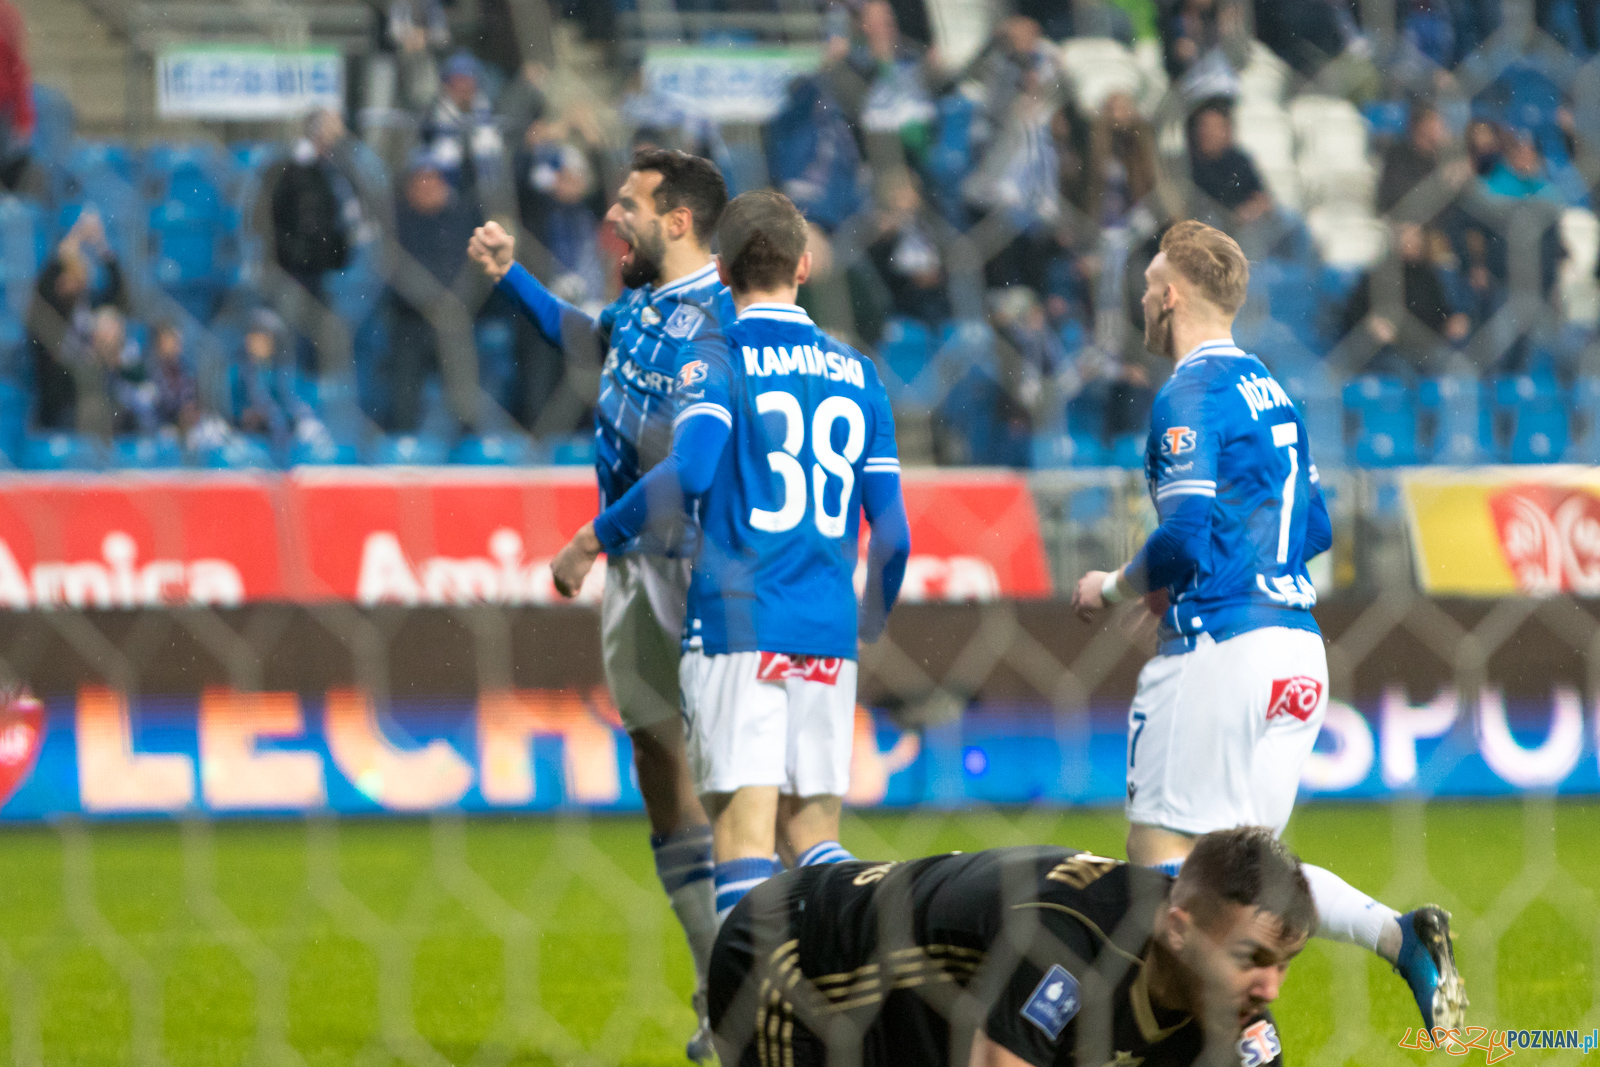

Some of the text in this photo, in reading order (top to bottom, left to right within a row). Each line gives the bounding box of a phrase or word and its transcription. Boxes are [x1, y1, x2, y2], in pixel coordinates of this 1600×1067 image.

[749, 390, 866, 538] 38
[1161, 426, 1197, 455] STS
[1271, 422, 1298, 564] 7
[1130, 711, 1147, 768] 7
[1239, 1020, 1282, 1066] STS
